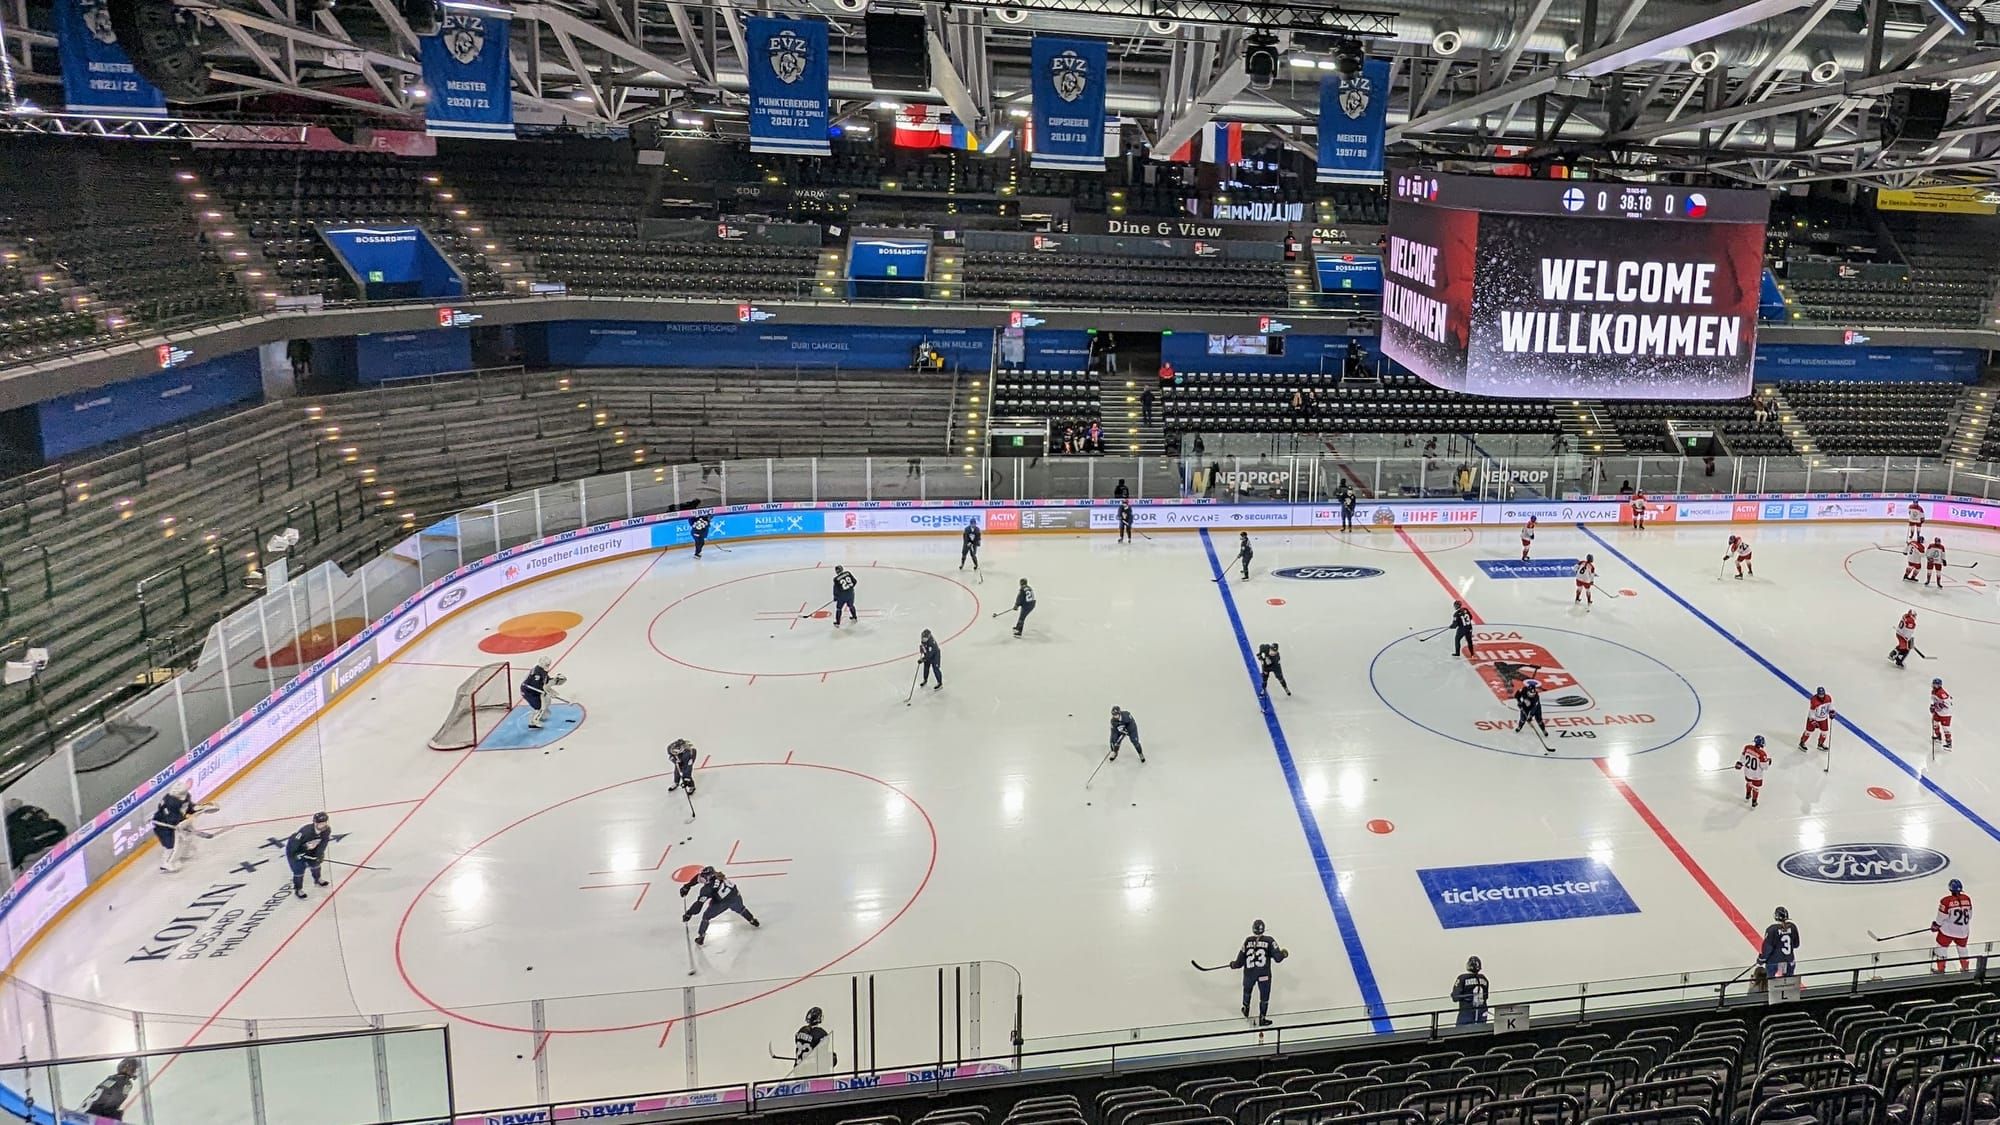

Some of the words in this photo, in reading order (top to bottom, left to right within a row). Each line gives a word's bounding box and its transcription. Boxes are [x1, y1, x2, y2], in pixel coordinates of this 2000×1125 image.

[442, 15, 483, 30] EVZ
[770, 38, 806, 52] EVZ
[1052, 58, 1086, 72] EVZ
[447, 80, 487, 92] MEISTER
[447, 97, 490, 108] 2020/21
[770, 117, 809, 128] 2020/21
[1336, 134, 1367, 144] MEISTER
[794, 190, 825, 198] WARM
[1598, 192, 1607, 211] 0
[1620, 194, 1652, 210] 38:18
[1665, 194, 1674, 214] 0
[1108, 220, 1150, 234] Dine
[1157, 222, 1172, 236] &
[1178, 224, 1222, 237] View
[1312, 228, 1348, 238] CASA
[1390, 236, 1438, 288] WELCOME
[1542, 258, 1716, 304] WELCOME
[1501, 310, 1740, 356] WILLKOMMEN
[1215, 472, 1290, 484] NEOPROP
[1481, 470, 1549, 482] NEOPROP
[731, 505, 748, 513] BWT
[1450, 512, 1478, 520] IIHF
[1960, 509, 1984, 518] BWT
[627, 518, 645, 526] BWT
[910, 514, 981, 523] OCHSNER
[1410, 512, 1438, 521] IIHF
[526, 538, 622, 570] #Together4Integrity
[1296, 566, 1362, 580] Ford
[840, 576, 852, 590] 29
[1460, 614, 1472, 626] 13
[340, 656, 372, 687] NEOPROP
[1557, 730, 1596, 739] Zug
[1744, 754, 1758, 771] 20
[1817, 848, 1918, 879] Ford
[1441, 880, 1600, 904] ticketmaster
[124, 883, 248, 964] KOLIN
[178, 908, 244, 961] BOSSARD
[1781, 934, 1792, 955] 3
[1246, 948, 1266, 968] 23
[1782, 990, 1788, 1000] L
[1507, 1018, 1516, 1030] K
[592, 1102, 636, 1118] BWT
[502, 1112, 548, 1125] BWT
